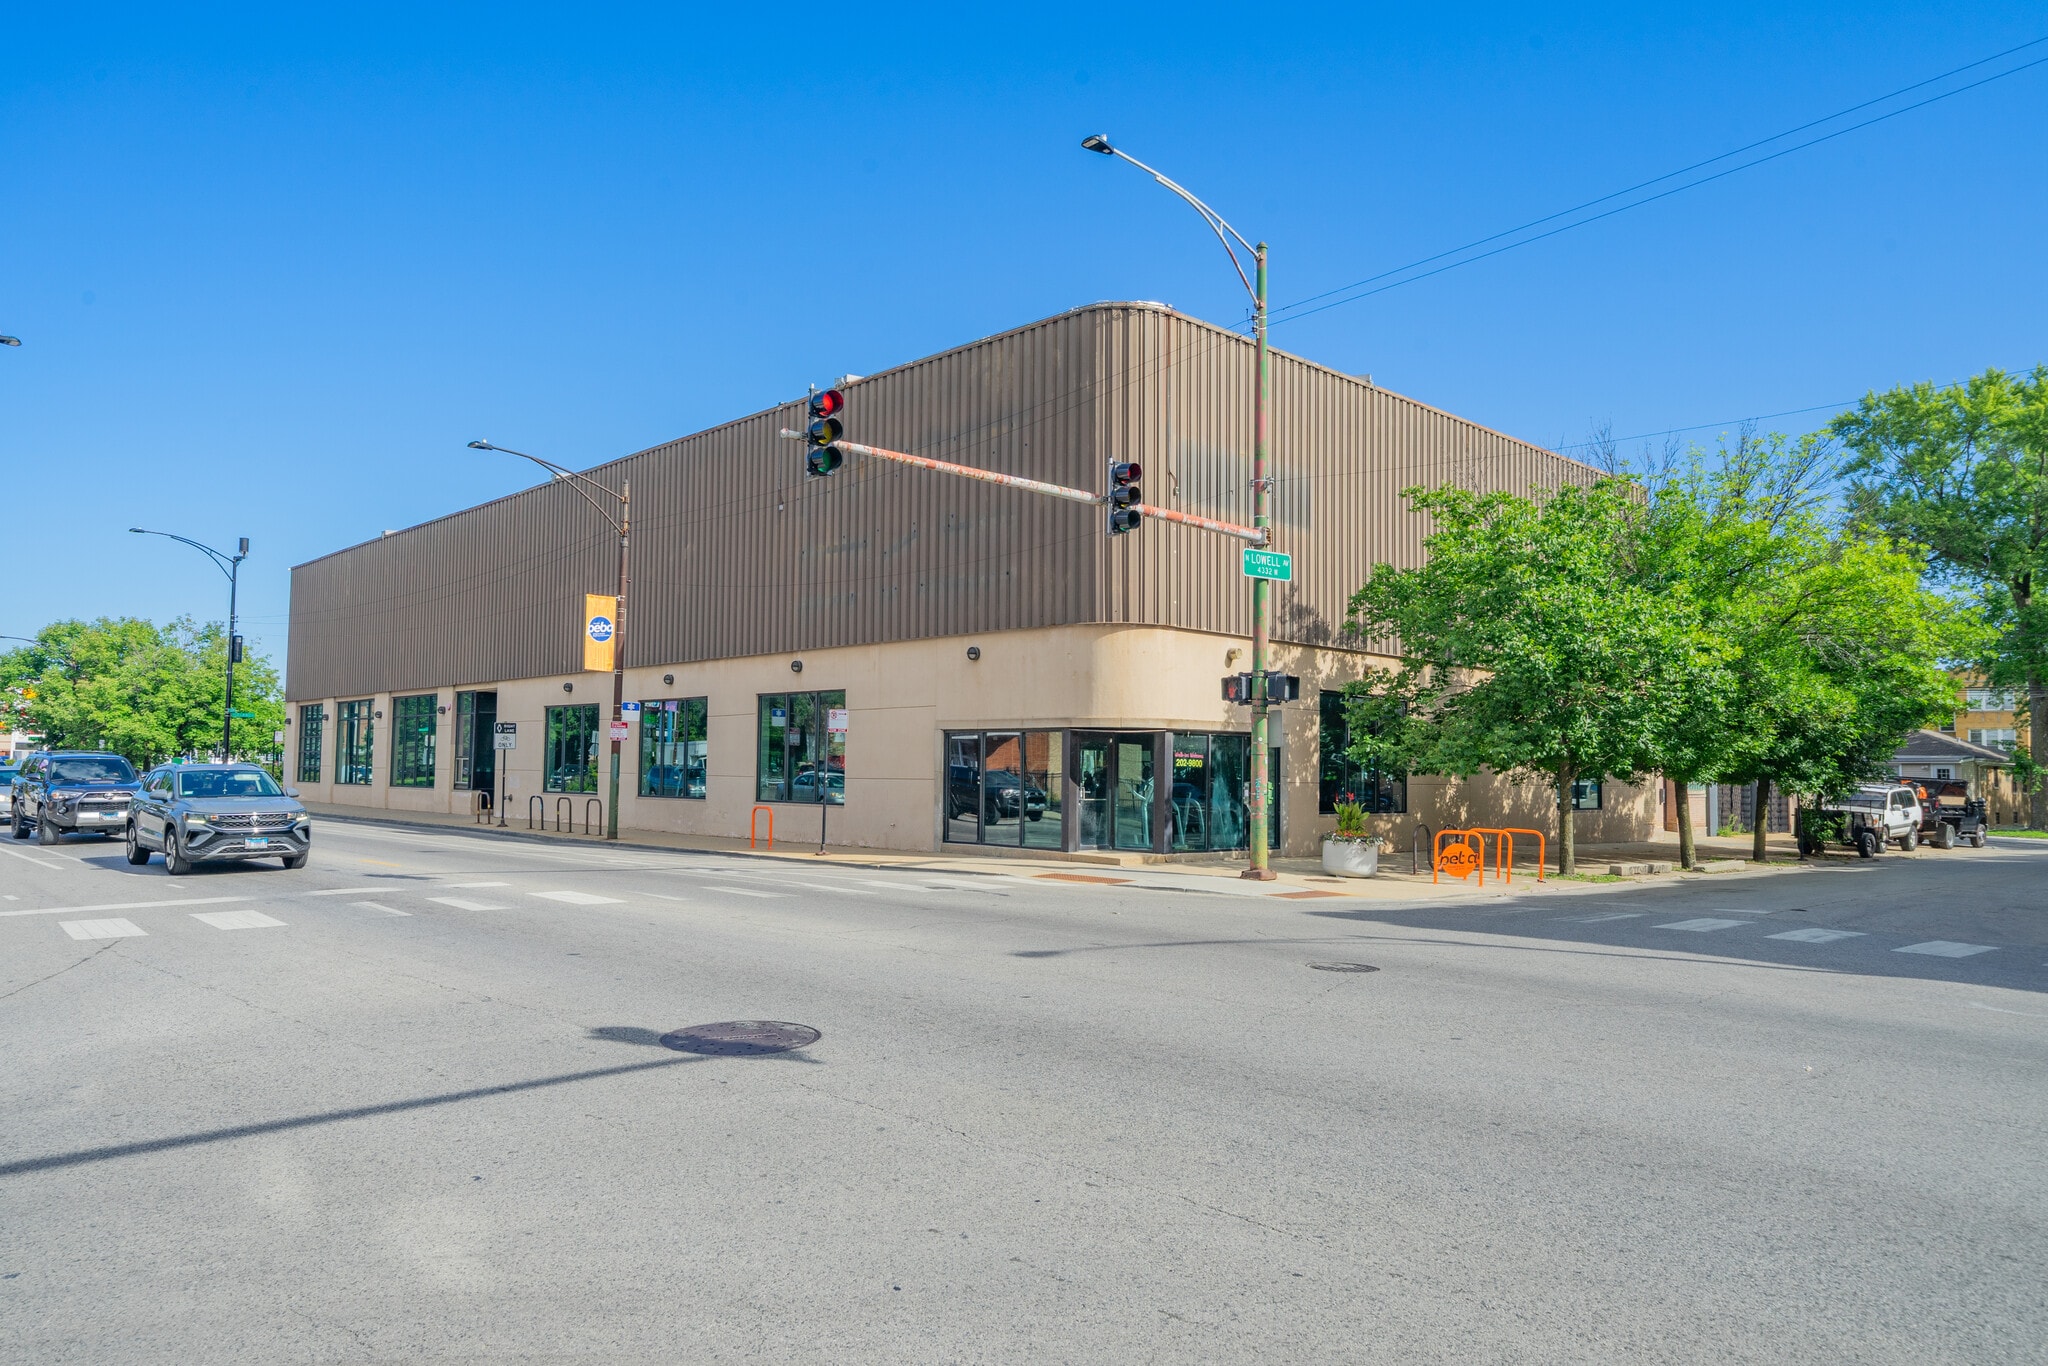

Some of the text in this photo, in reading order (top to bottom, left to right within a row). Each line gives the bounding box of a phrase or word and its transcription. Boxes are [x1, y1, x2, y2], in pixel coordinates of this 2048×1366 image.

[1245, 553, 1290, 568] N LOWELL AV
[1257, 566, 1273, 576] 4332
[1175, 758, 1203, 768] 202-9800
